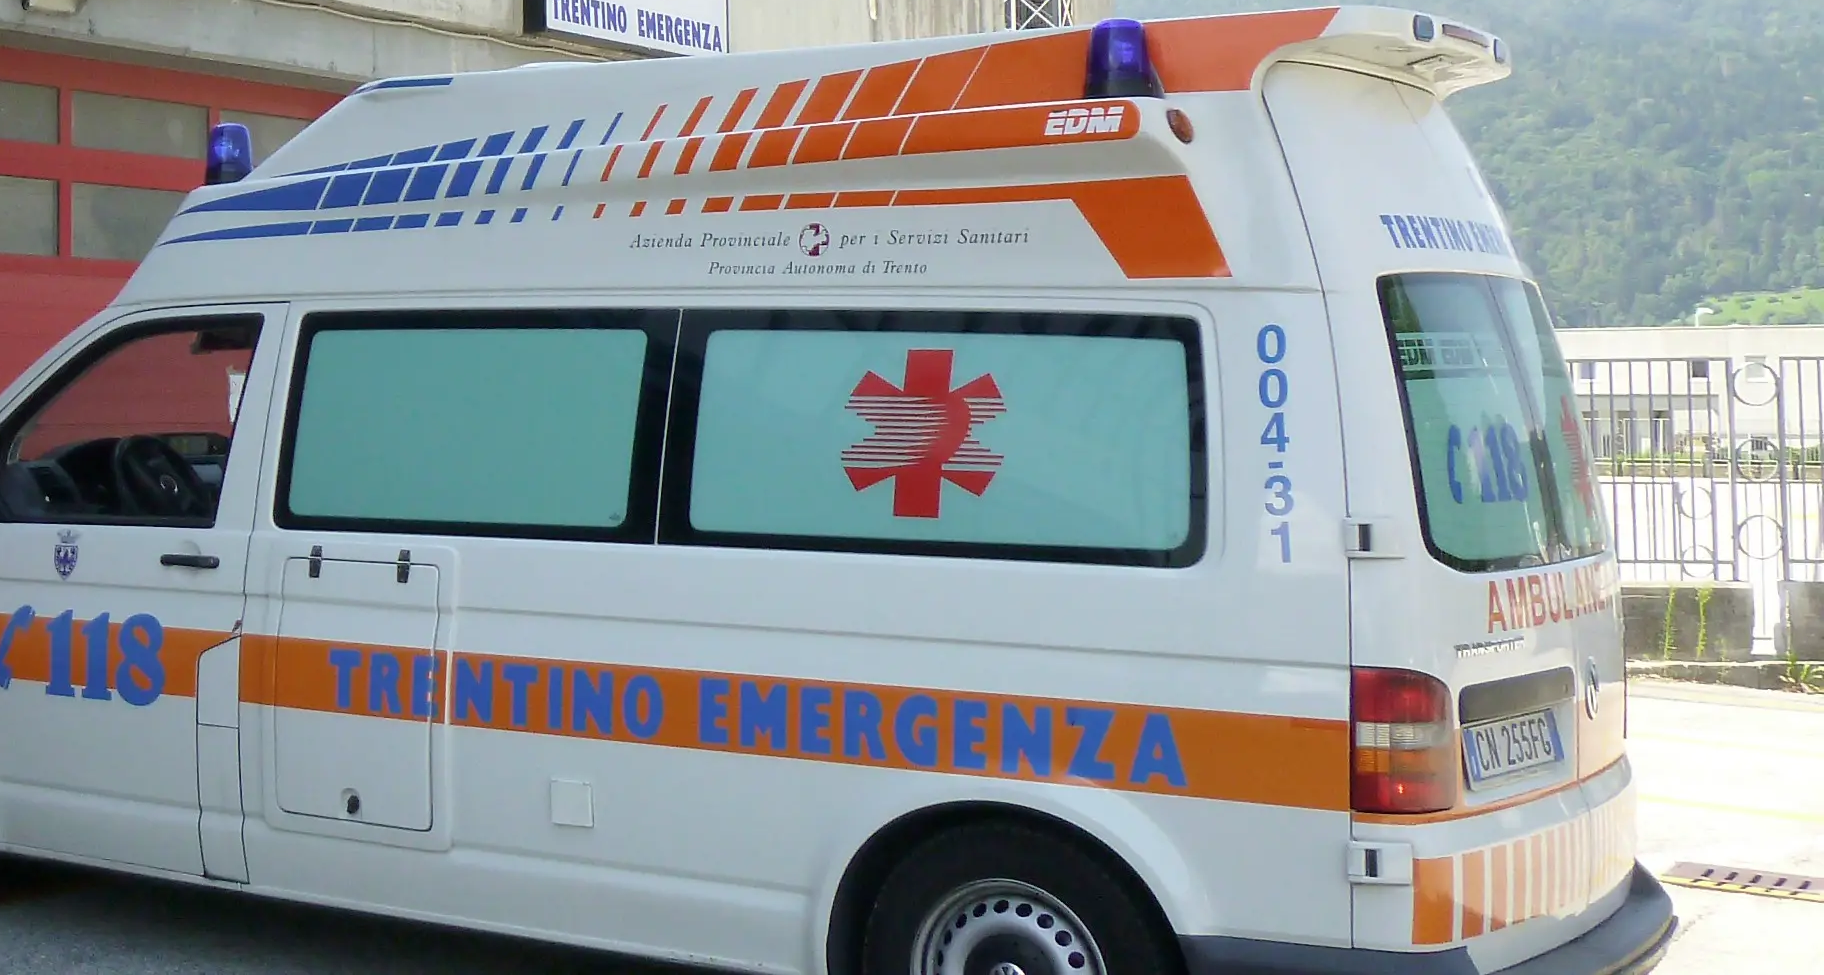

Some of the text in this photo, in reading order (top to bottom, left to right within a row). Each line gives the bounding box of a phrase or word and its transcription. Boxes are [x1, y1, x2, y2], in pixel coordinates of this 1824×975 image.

[637, 9, 723, 53] EMERGENZA
[1044, 106, 1125, 136] EDM
[629, 233, 692, 248] Azienda
[699, 231, 791, 248] Provinciale
[839, 234, 866, 249] per
[887, 229, 949, 245] Servizi
[957, 228, 1030, 244] Sanitari
[708, 260, 928, 275] Provincia Autonoma di Trento
[1256, 323, 1295, 564] 004-31
[1467, 421, 1530, 503] 118
[45, 609, 166, 707] 118
[329, 648, 1188, 788] TRENTINO EMERGENZA
[1475, 727, 1502, 771] CN
